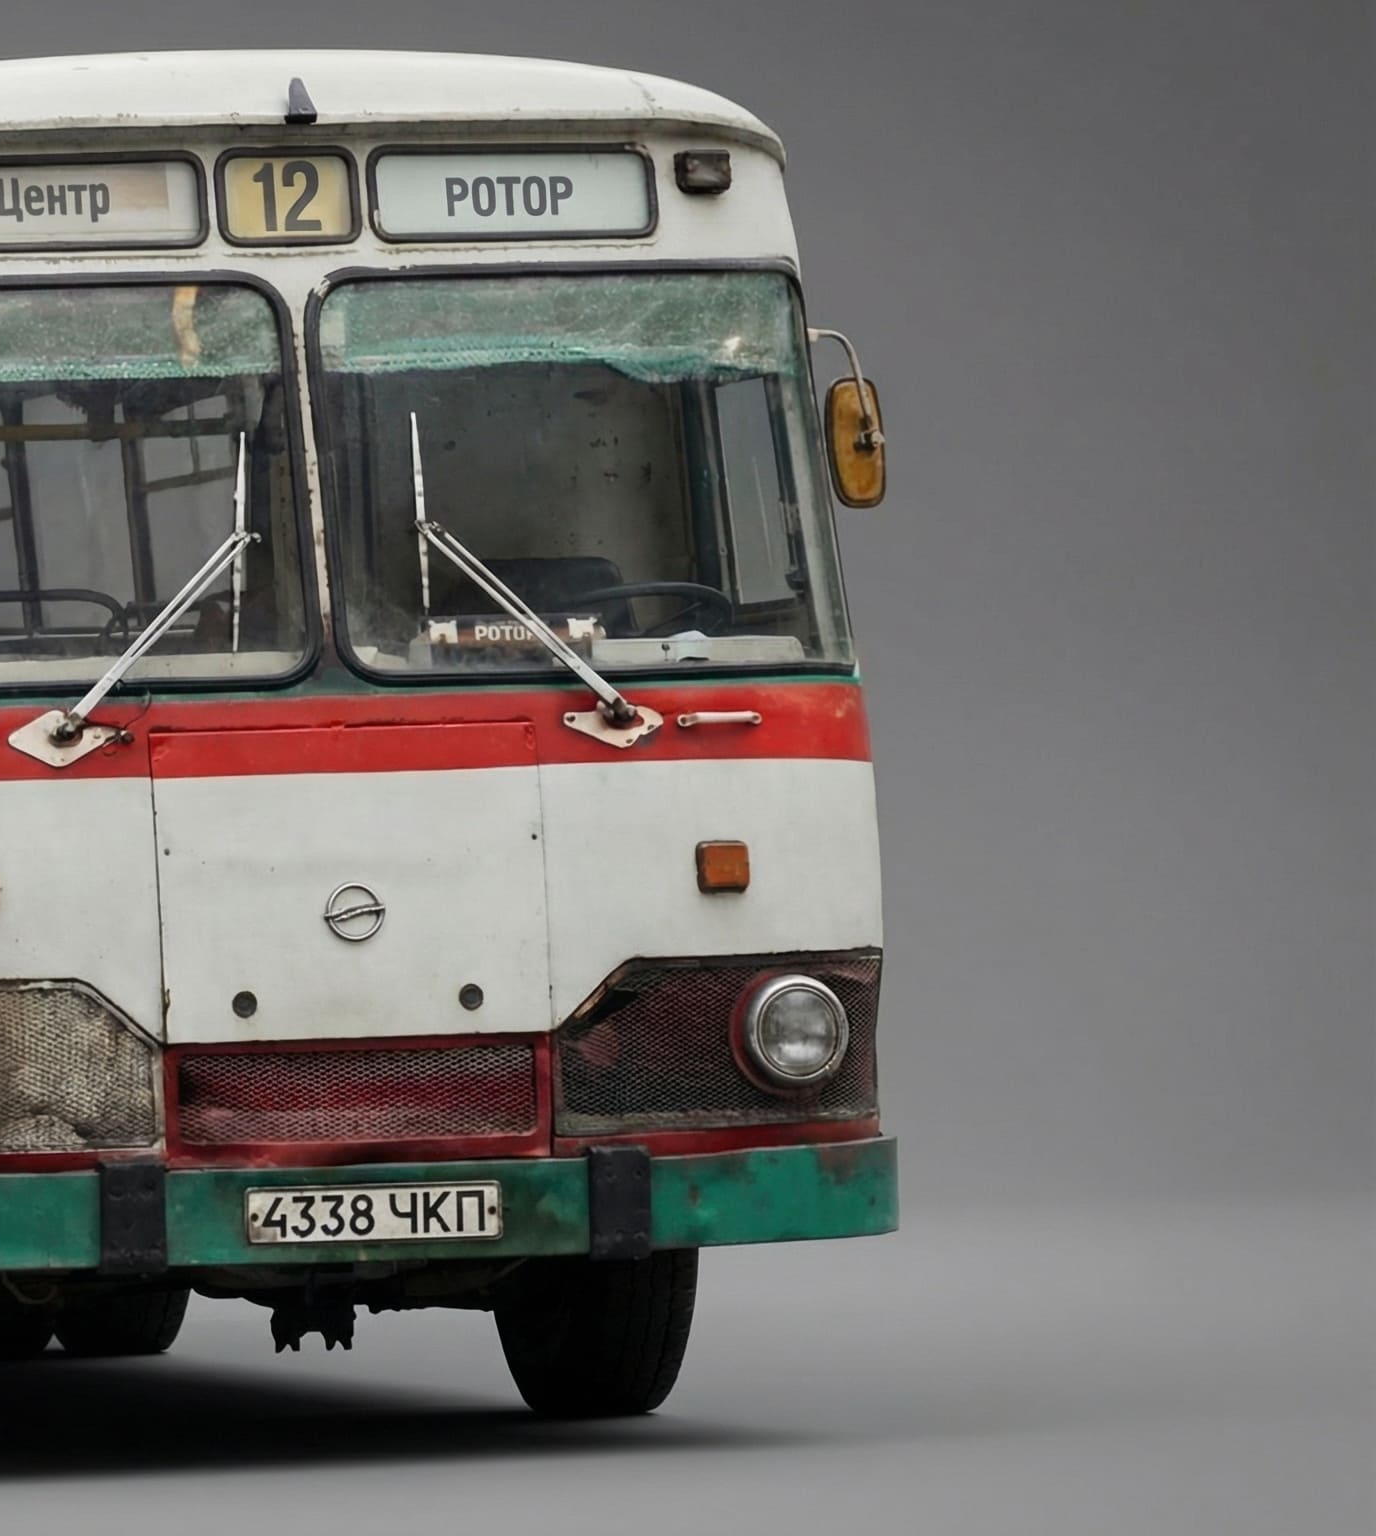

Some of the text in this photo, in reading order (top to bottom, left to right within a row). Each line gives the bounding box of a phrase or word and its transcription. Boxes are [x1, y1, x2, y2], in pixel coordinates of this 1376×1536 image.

[252, 160, 322, 232] 12
[445, 175, 573, 217] РОТОР
[261, 1190, 485, 1238] 4338 ЧКП
